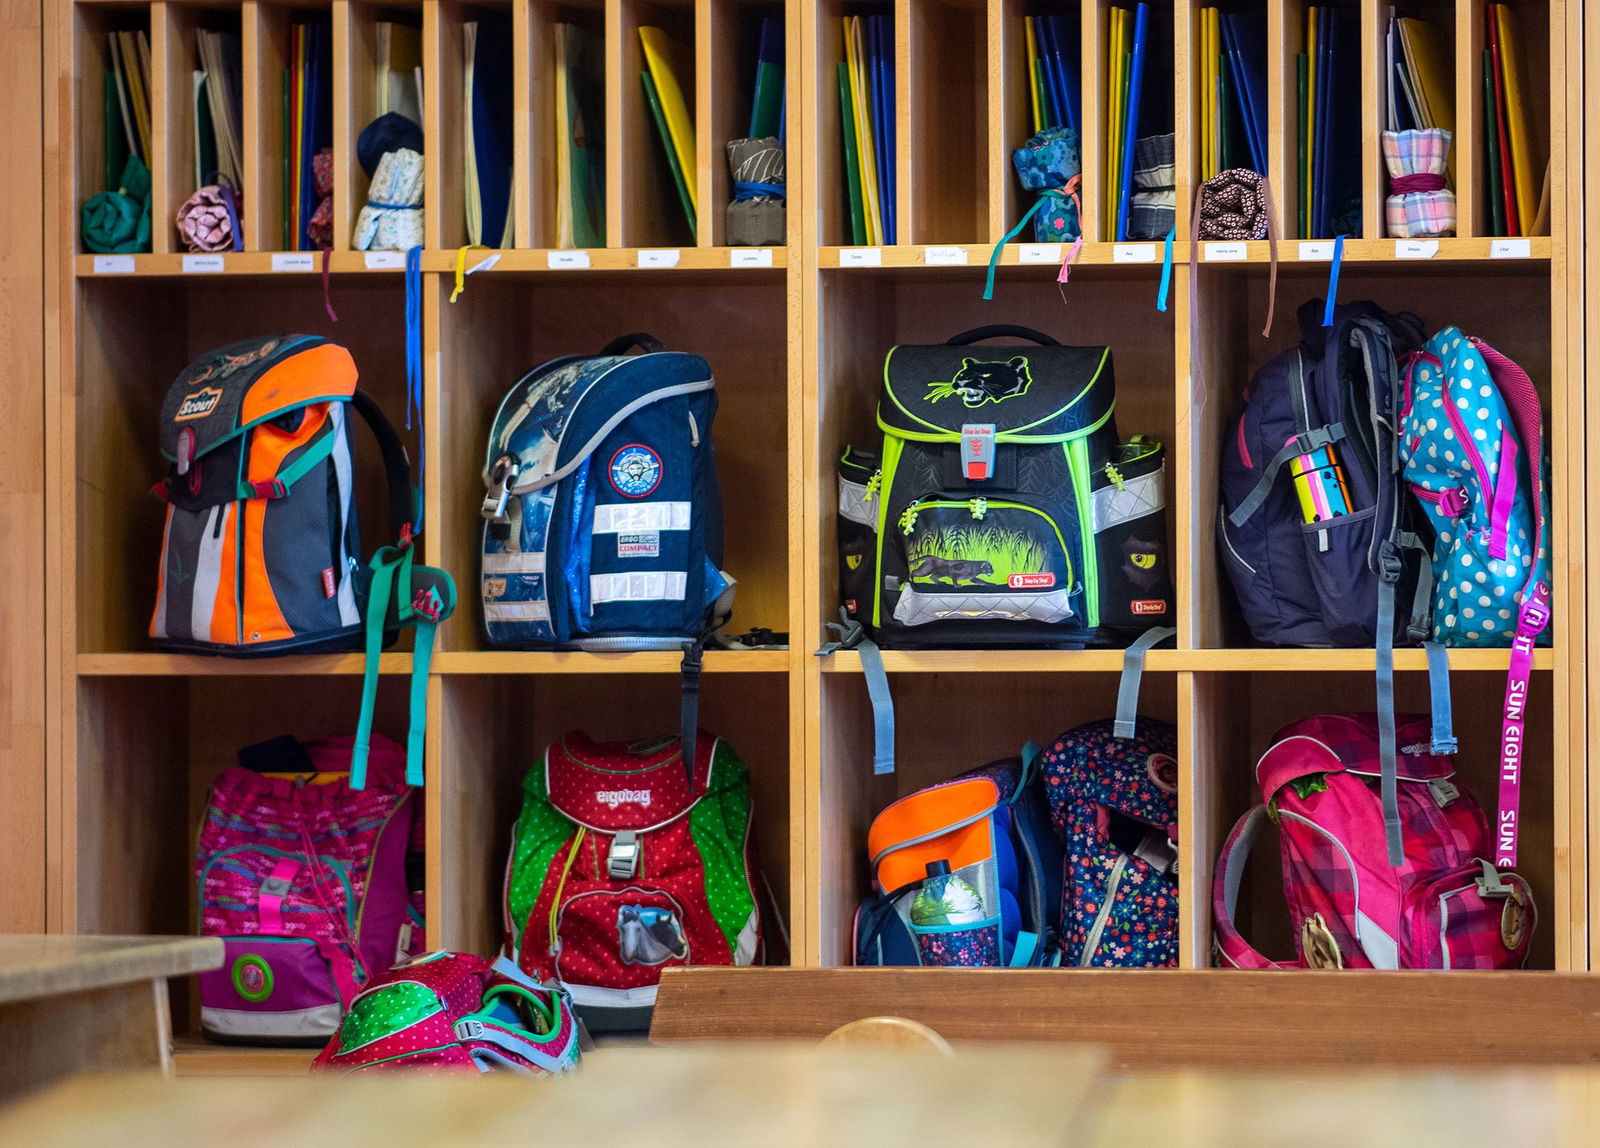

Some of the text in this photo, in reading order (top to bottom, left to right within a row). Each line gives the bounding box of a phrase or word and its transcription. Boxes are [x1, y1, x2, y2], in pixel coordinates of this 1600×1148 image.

[181, 397, 215, 415] Scout
[1507, 679, 1525, 720] SUN
[1503, 725, 1520, 784] EIGHT
[596, 789, 651, 808] ergobag
[1500, 810, 1515, 850] SUN
